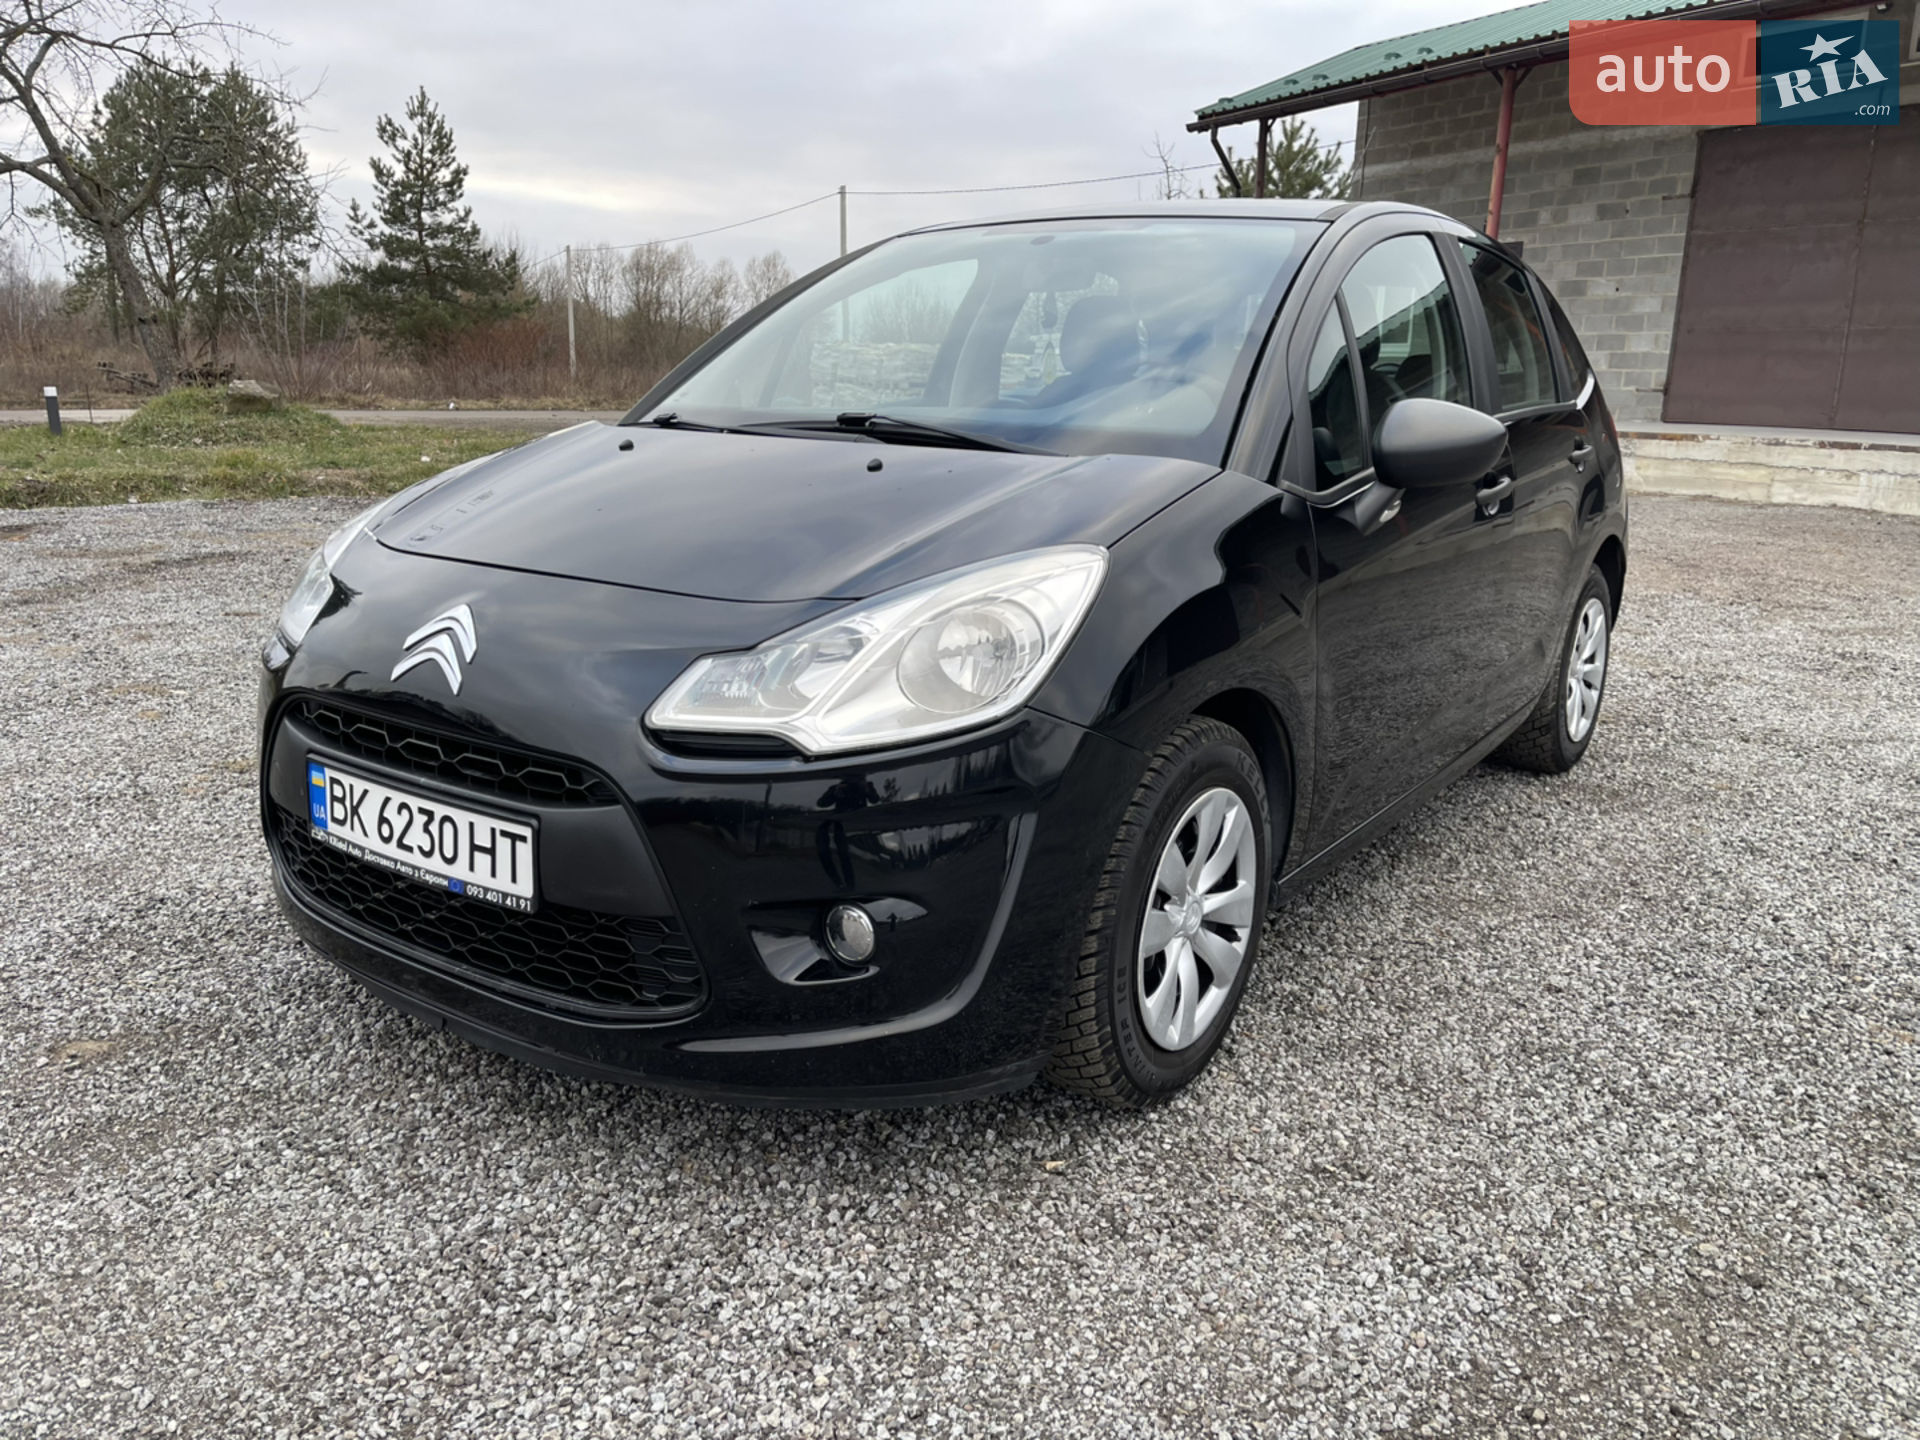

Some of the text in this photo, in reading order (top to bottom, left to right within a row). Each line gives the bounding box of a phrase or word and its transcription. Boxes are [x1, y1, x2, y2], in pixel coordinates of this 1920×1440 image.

[1235, 752, 1271, 825] KELLY
[313, 805, 326, 820] UA
[329, 776, 528, 885] BK 6230 HT
[466, 884, 484, 898] 093
[486, 891, 502, 904] 401
[505, 896, 516, 907] 41
[519, 899, 531, 911] 91
[1116, 966, 1127, 1005] ICE
